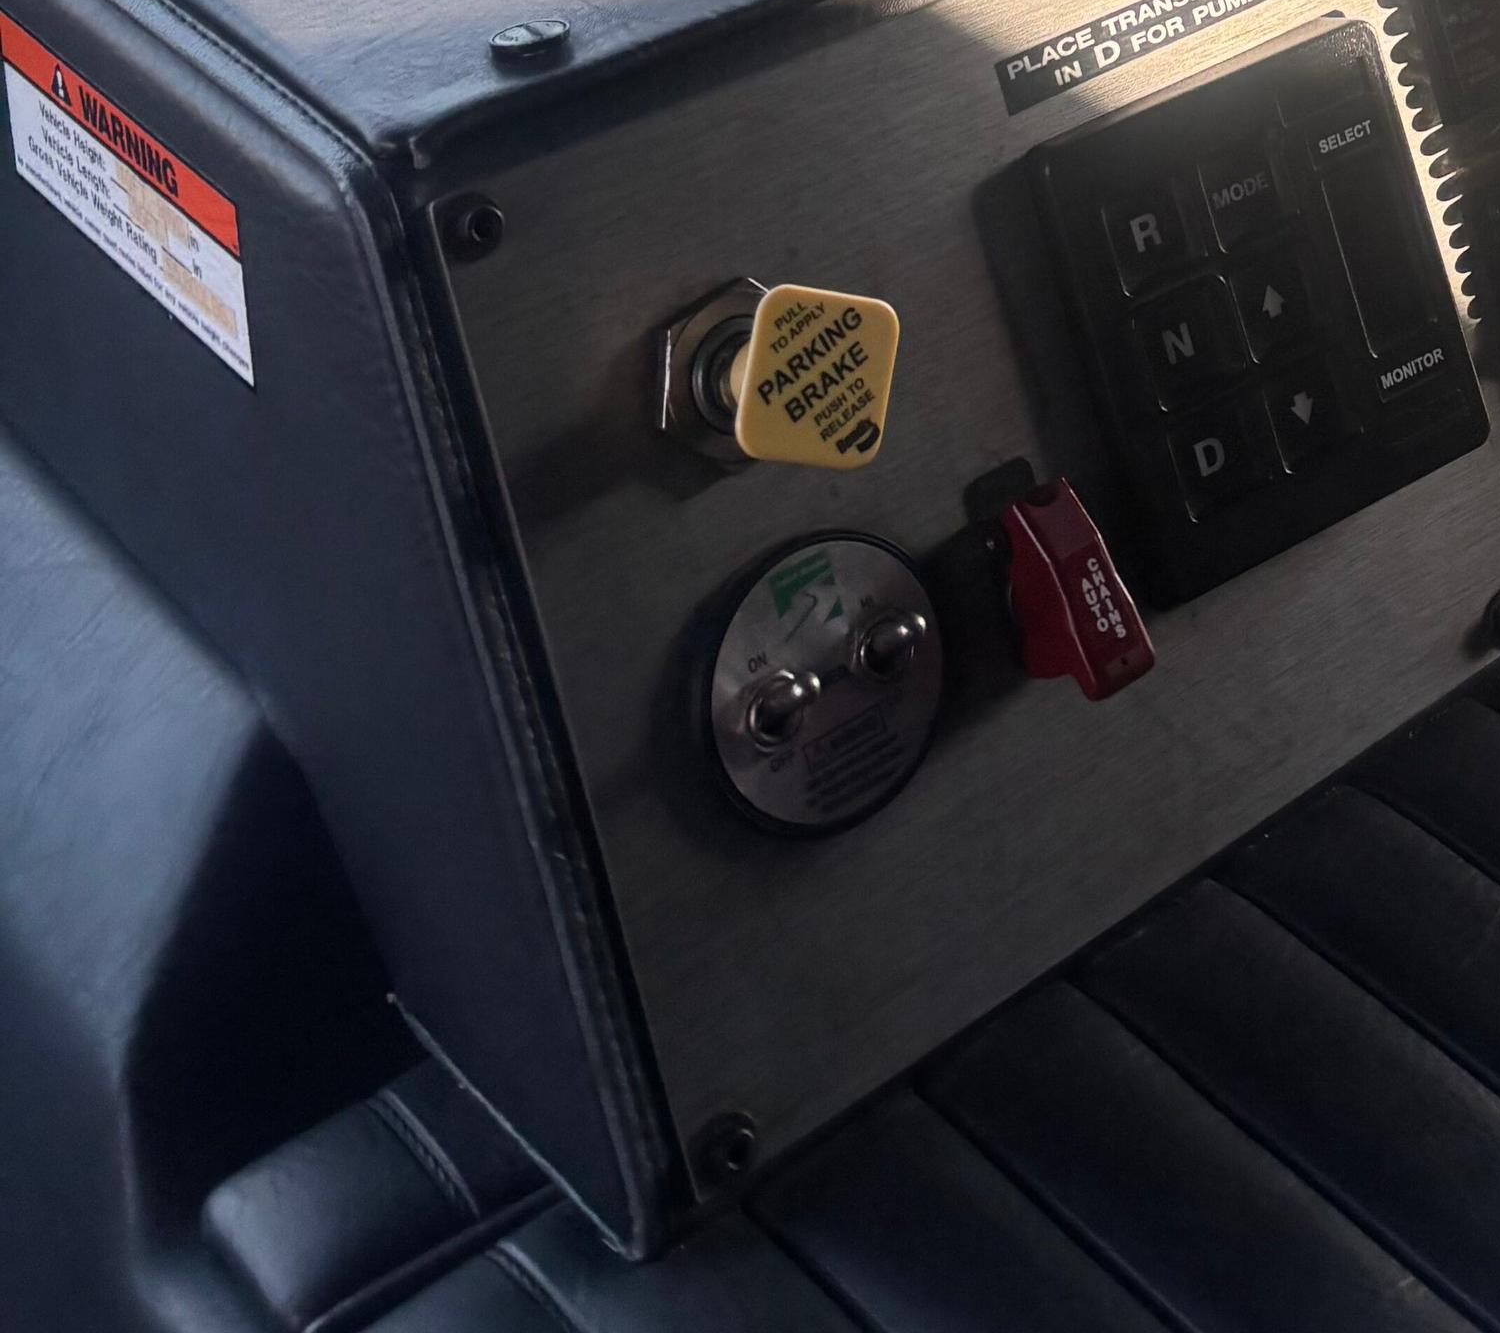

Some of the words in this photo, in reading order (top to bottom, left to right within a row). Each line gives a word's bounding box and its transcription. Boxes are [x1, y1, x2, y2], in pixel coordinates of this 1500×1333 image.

[1006, 27, 1096, 81] PLACE
[1054, 60, 1083, 86] IN
[1093, 40, 1122, 69] D
[1130, 16, 1186, 53] FOR
[38, 98, 72, 139] Vehicle
[73, 128, 107, 173] Height:
[79, 86, 178, 197] WARNING
[1318, 120, 1373, 155] SELECT
[41, 126, 75, 166] Vehicle
[76, 156, 111, 201] Length:
[28, 135, 54, 168] Gross
[56, 160, 89, 202] Vehicle
[92, 189, 124, 232] Weight
[126, 220, 158, 267] Rating
[1212, 172, 1270, 209] MODE
[1130, 213, 1162, 253] R
[770, 335, 789, 354] TO
[788, 301, 826, 342] APPLY
[774, 300, 808, 331] PULL
[758, 307, 863, 406] PARKING
[1161, 322, 1196, 365] N
[1380, 347, 1446, 390] MONITOR
[784, 341, 870, 424] BRAKE
[813, 394, 848, 427] PUSH
[848, 377, 865, 397] TO
[819, 389, 875, 442] RELEASE
[1193, 437, 1226, 478] D
[1082, 577, 1109, 633] AUTO
[1087, 557, 1127, 639] CHAINS
[747, 650, 769, 675] ON
